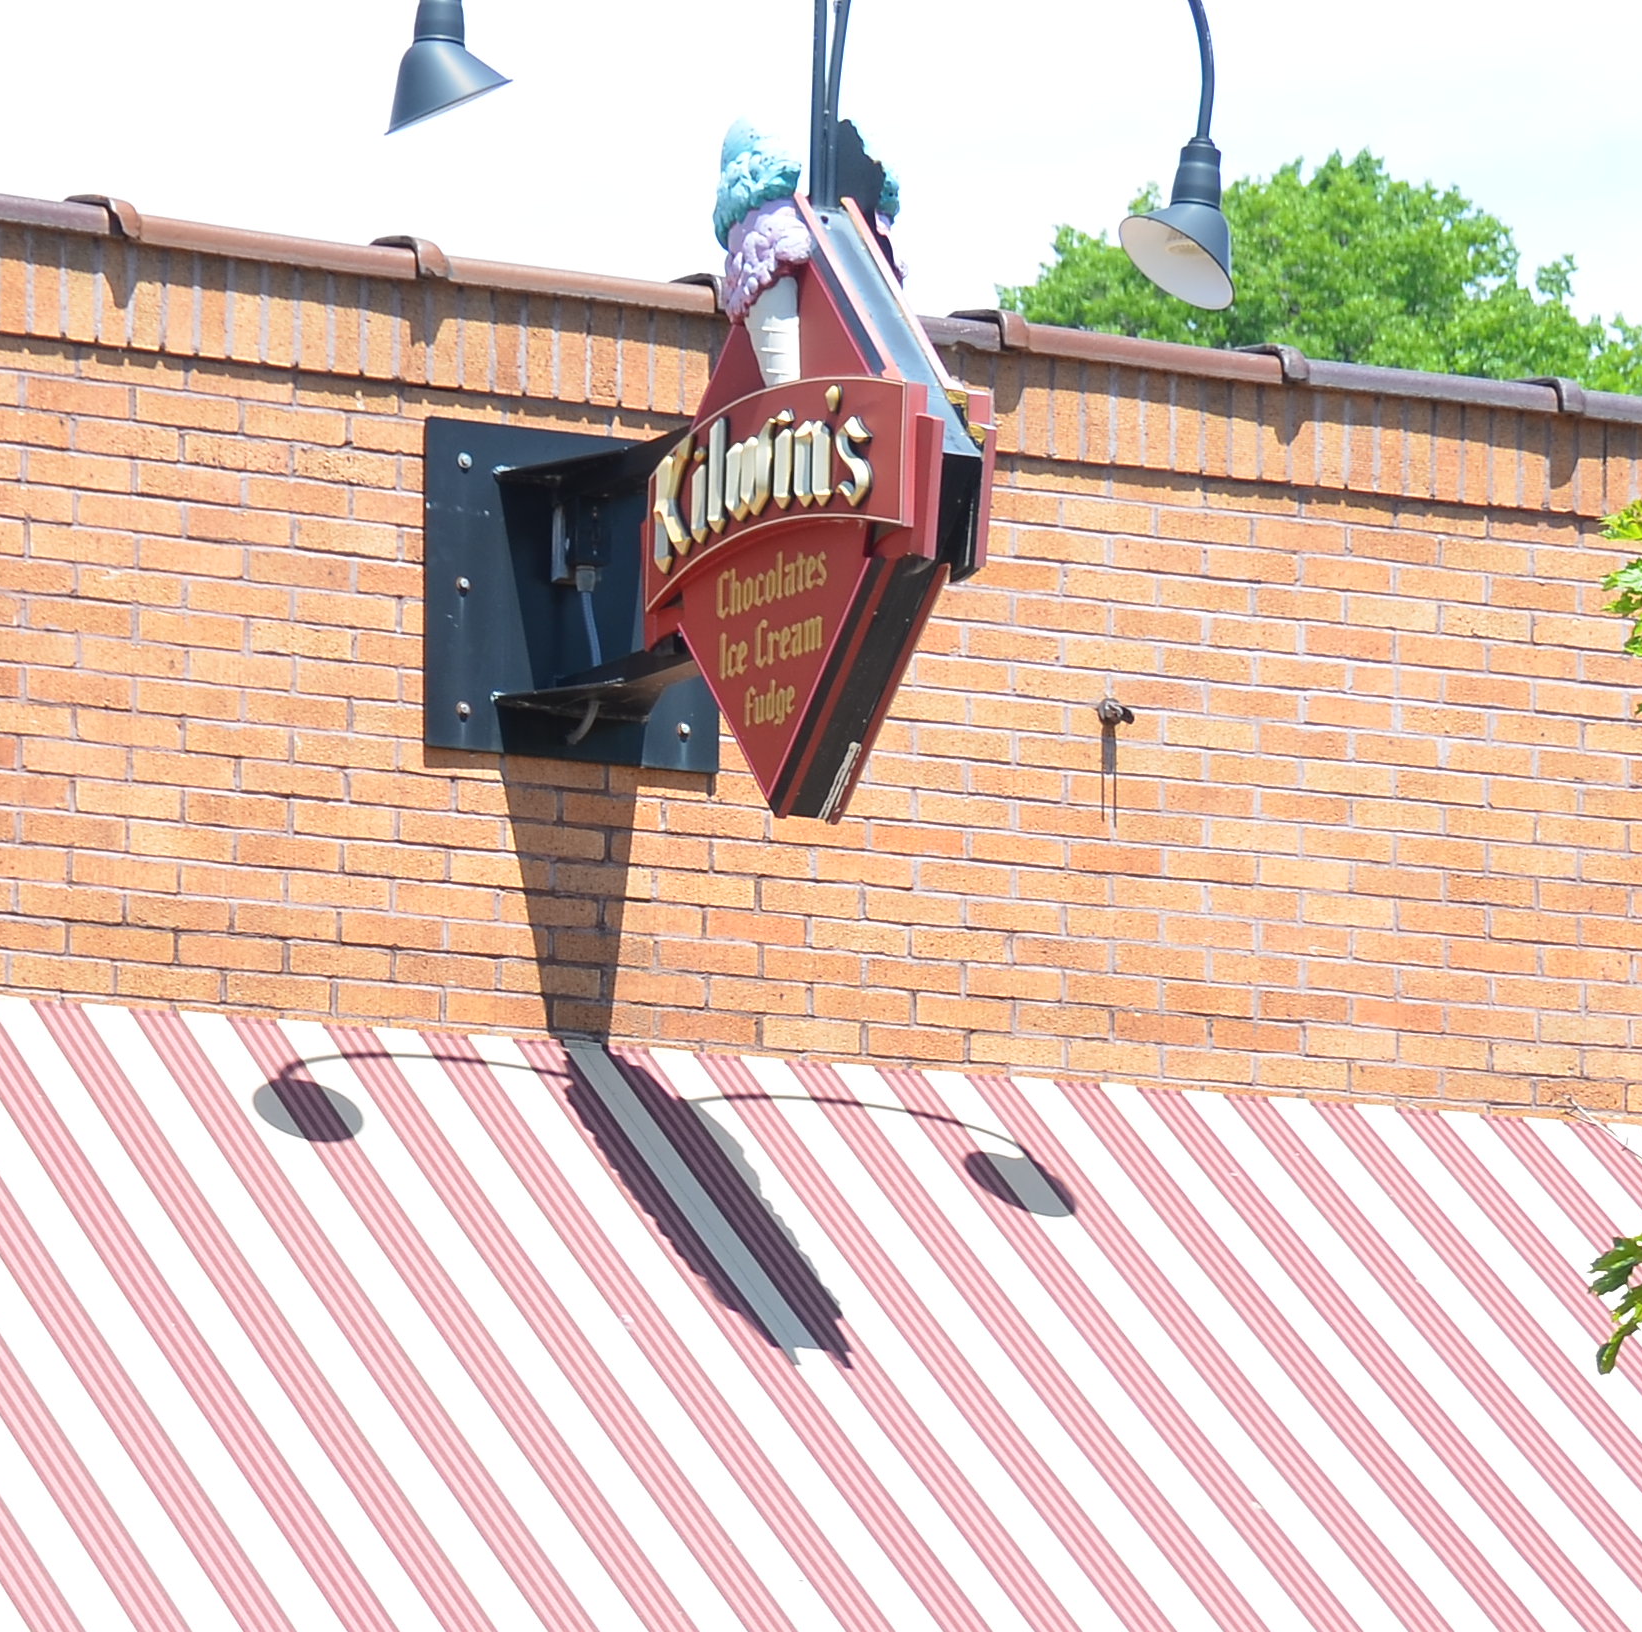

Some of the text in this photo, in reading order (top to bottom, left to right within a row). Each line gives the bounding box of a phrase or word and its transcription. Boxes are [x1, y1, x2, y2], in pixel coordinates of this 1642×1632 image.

[653, 384, 873, 574] Kilwin's
[717, 551, 827, 619] Chocolates
[719, 616, 823, 680] Ice Cream
